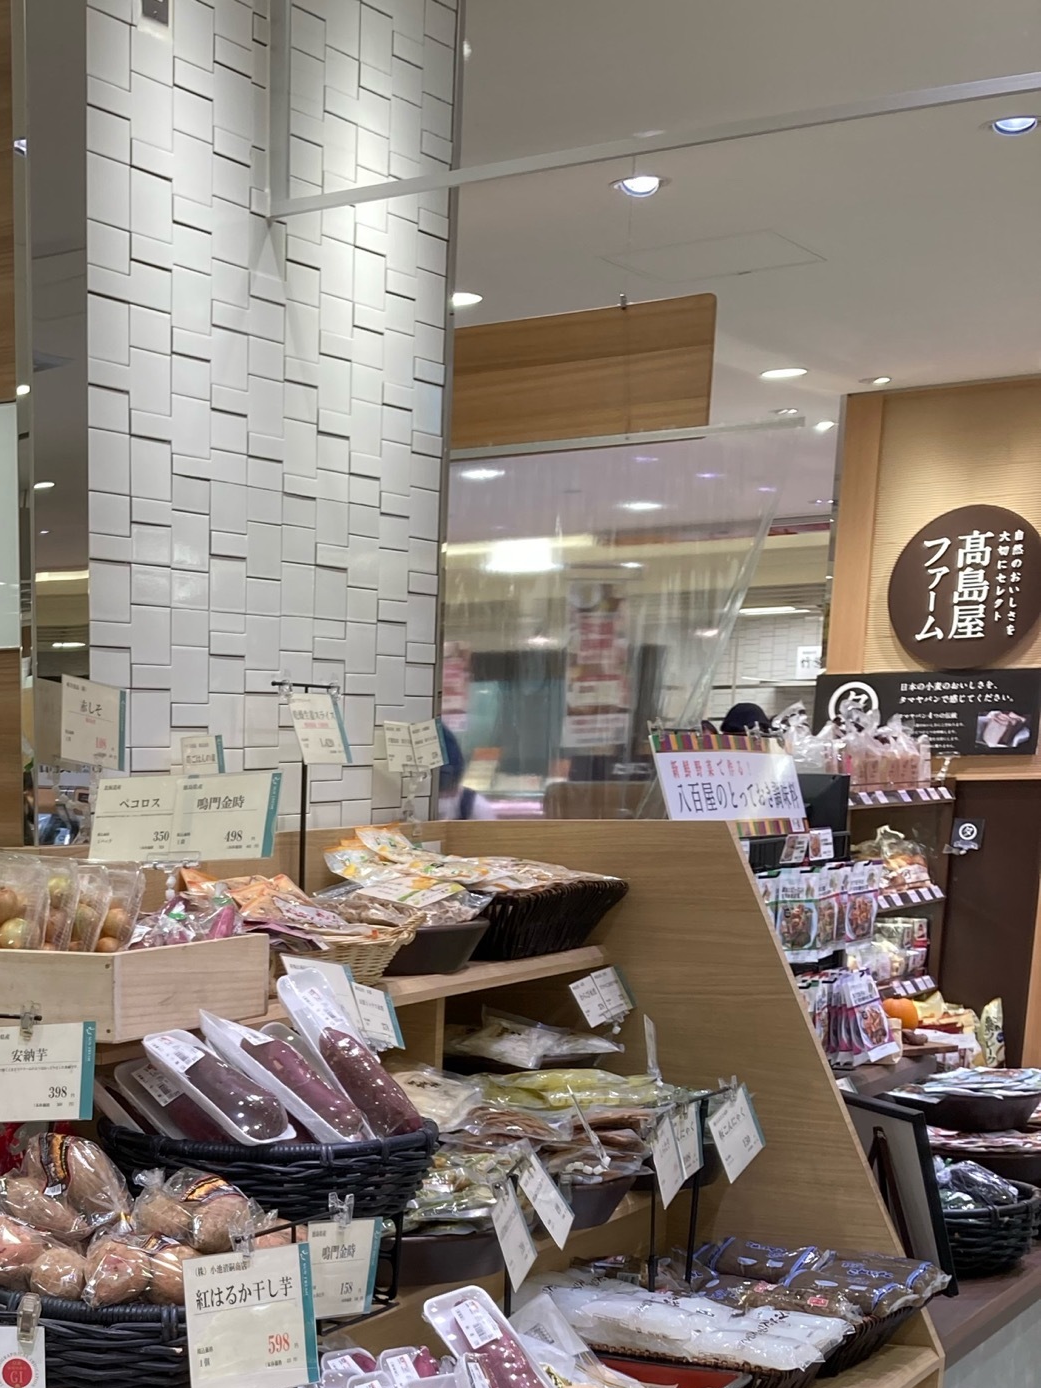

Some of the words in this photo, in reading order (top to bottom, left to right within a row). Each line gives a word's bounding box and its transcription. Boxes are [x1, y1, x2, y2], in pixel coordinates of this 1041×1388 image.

[993, 530, 1011, 622] 大切にセレクト
[1006, 529, 1024, 636] 自然のおいしさを
[915, 537, 952, 642] ファーム
[196, 795, 246, 811] 鳴門金時
[152, 830, 170, 843] 350
[223, 830, 244, 843] 498
[11, 1048, 48, 1063] 安納芋
[48, 1086, 68, 1099] 398
[195, 1276, 293, 1311] 紅はるか干し芋
[339, 1281, 353, 1296] 158
[267, 1332, 290, 1354] 598
[9, 1371, 24, 1384] GI
